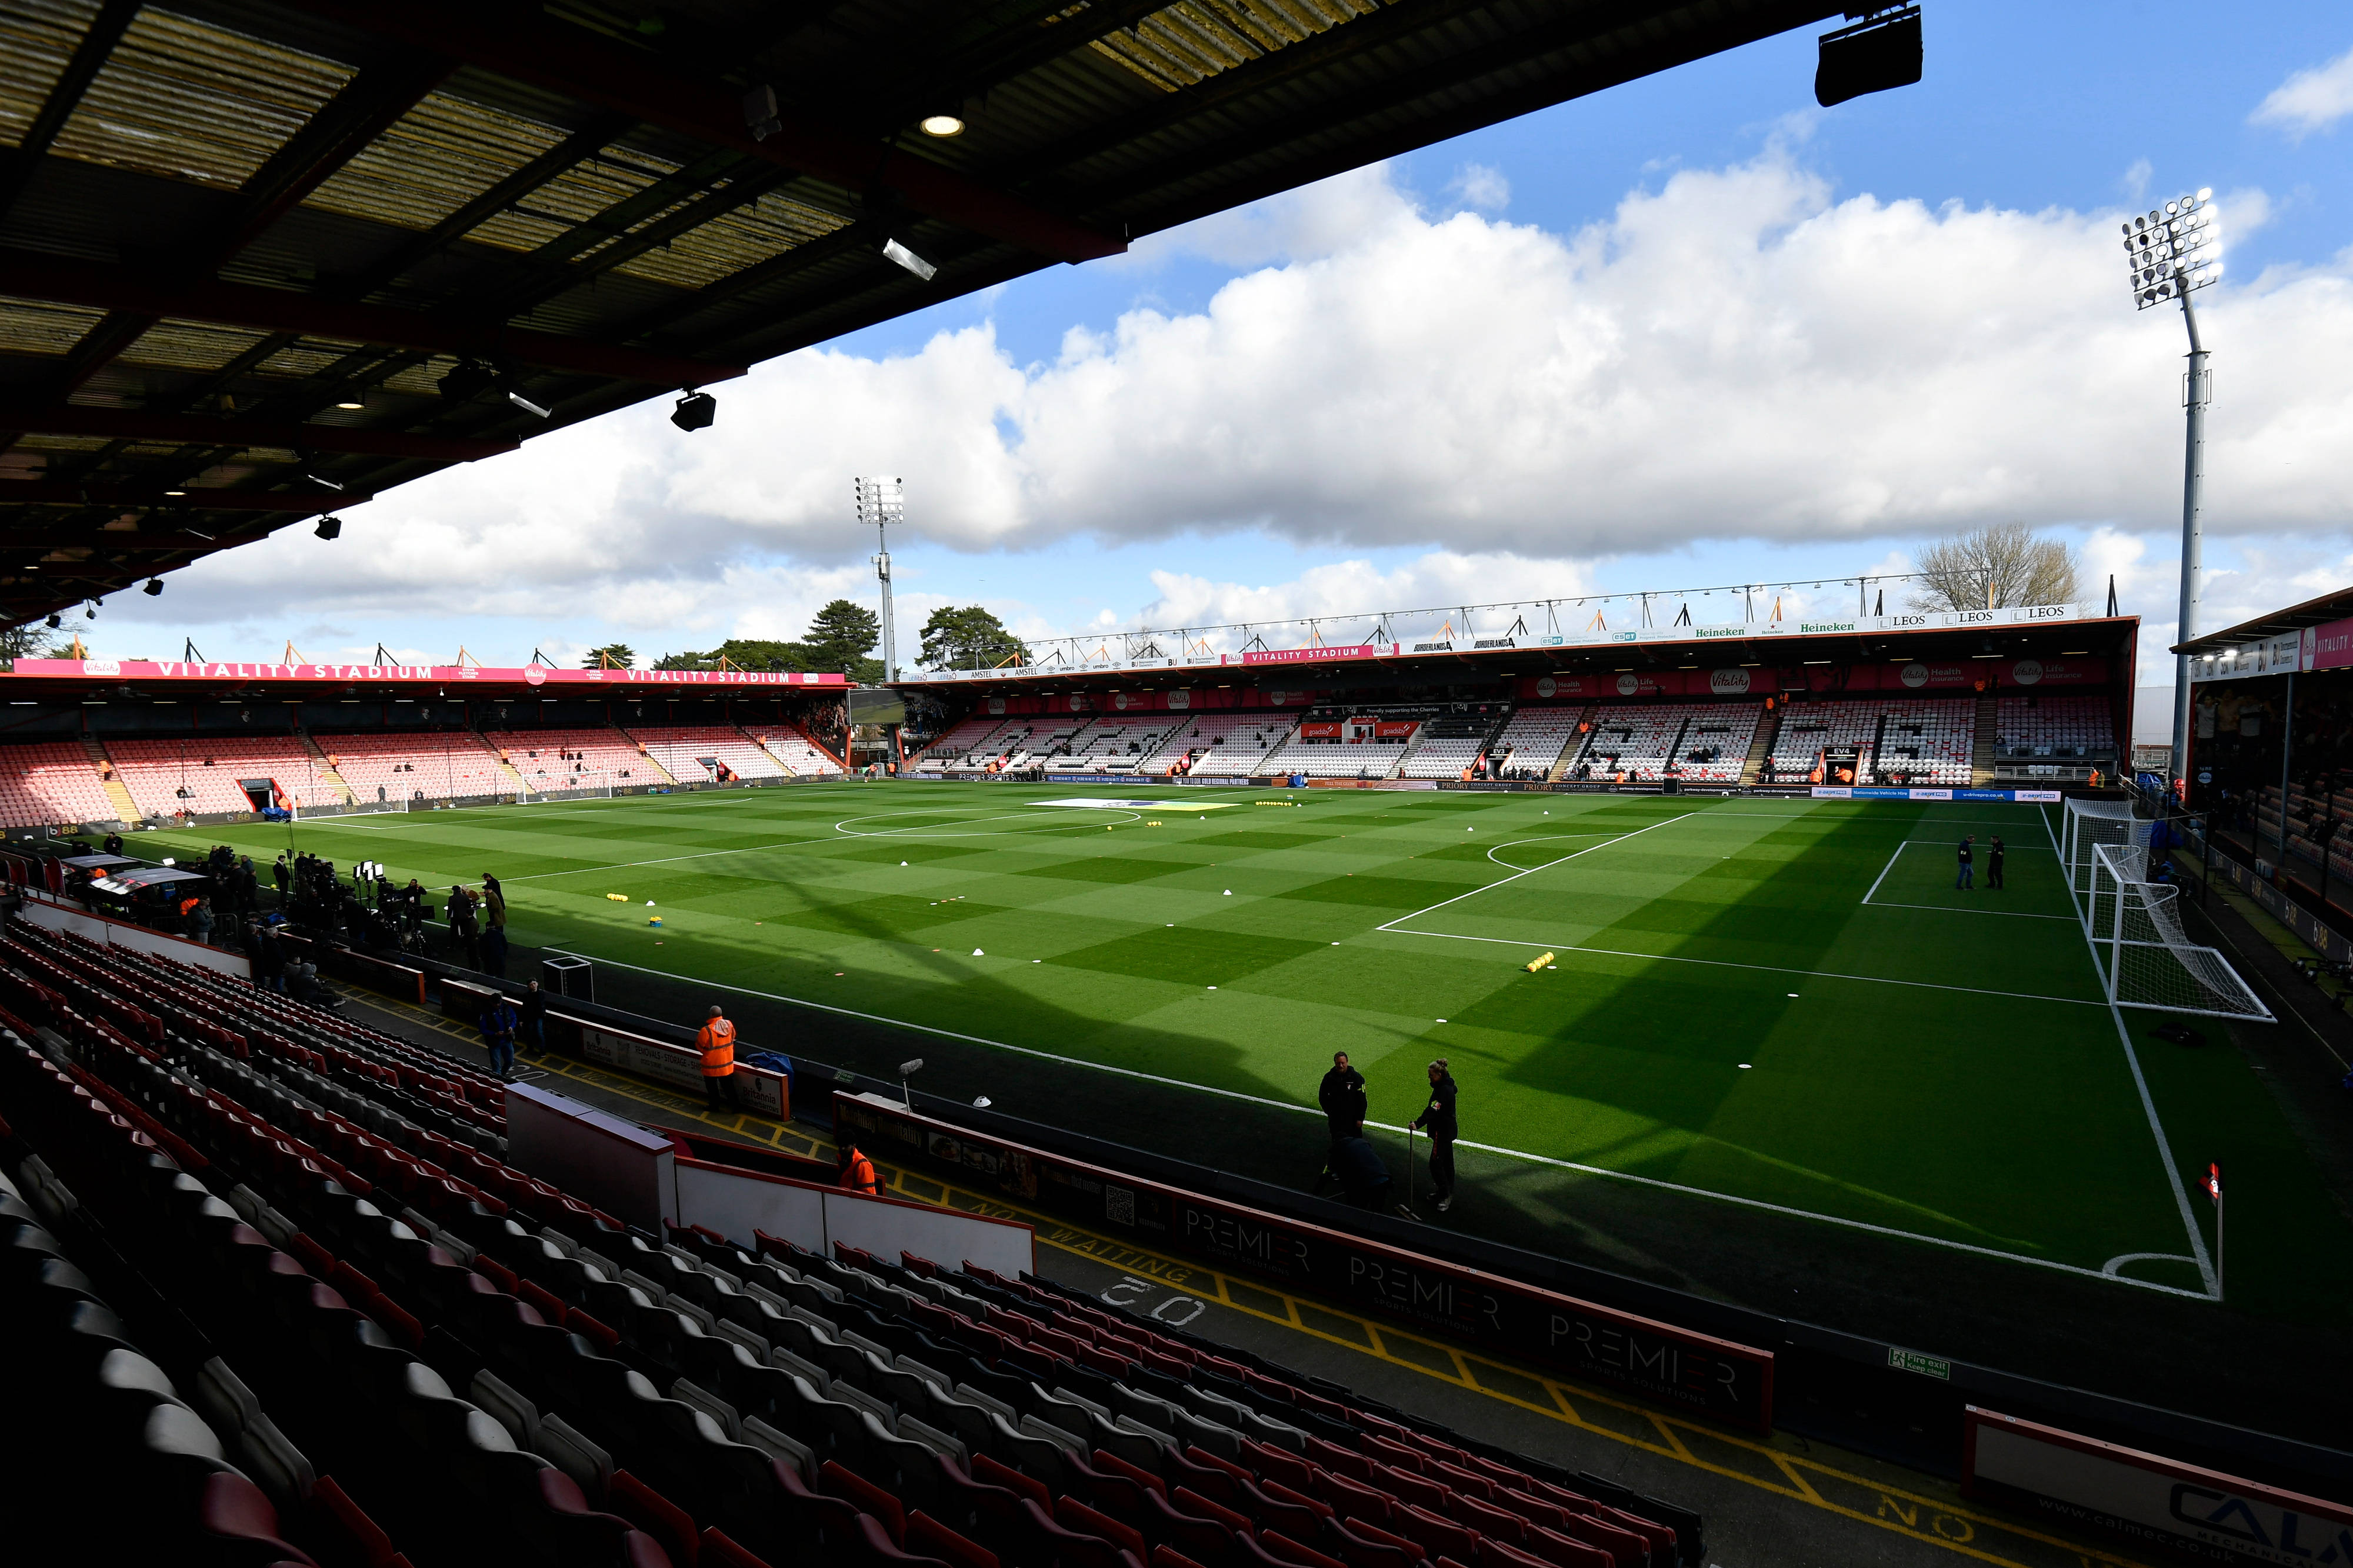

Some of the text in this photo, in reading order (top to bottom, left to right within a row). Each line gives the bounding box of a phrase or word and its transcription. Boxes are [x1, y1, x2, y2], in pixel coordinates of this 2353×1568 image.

[1958, 612, 1993, 622] LEOS
[2028, 607, 2064, 618] LEOS
[1801, 622, 1855, 632] Heineken
[1892, 616, 1925, 626] LEOS
[1696, 628, 1745, 638] Heineken
[1373, 645, 1394, 655] Vitality
[2318, 635, 2348, 653] VITALITY
[1226, 655, 1243, 663] Vitality
[1252, 648, 1359, 661] VITALITY STADIUM
[85, 661, 119, 673] Vitality
[158, 662, 432, 679] VITALITY STADIUM
[524, 668, 546, 678] Vitality
[1015, 668, 1038, 676] AMSTEL
[2014, 665, 2041, 678] Vitality
[627, 670, 789, 683] VITALITY STADIUM
[971, 670, 992, 679] AMSTEL
[1712, 672, 1748, 690] Vitality
[1902, 670, 1928, 682] Vitality
[1537, 682, 1556, 693] Vitality
[1618, 679, 1637, 690] Vitality
[1168, 692, 1189, 706] Vitality
[1309, 728, 1329, 736] goadsby
[1383, 727, 1405, 735] goadsby
[586, 1042, 611, 1056] Britannia
[635, 1047, 660, 1060] REMOVALS
[664, 1053, 686, 1067] STORAGE
[743, 1086, 776, 1104] Britannia
[969, 1201, 1016, 1222] NO
[1187, 1209, 1311, 1272] PREMIER
[1049, 1229, 1193, 1283] WAITING
[1207, 1245, 1290, 1277] SPORTS SOLUTIONS
[1351, 1256, 1501, 1330] PREMIER
[1101, 1276, 1206, 1327] 50
[1374, 1297, 1475, 1335] SPORTS SOLUTIONS
[1551, 1314, 1738, 1402] PREMIER
[1908, 1353, 1946, 1370] Fire exit
[1907, 1362, 1945, 1377] Keep clear
[1579, 1360, 1707, 1406] SPORTS SOLUTIONS
[1878, 1495, 1974, 1543] NO
[2037, 1496, 2236, 1564] www.calmec.co.uk
